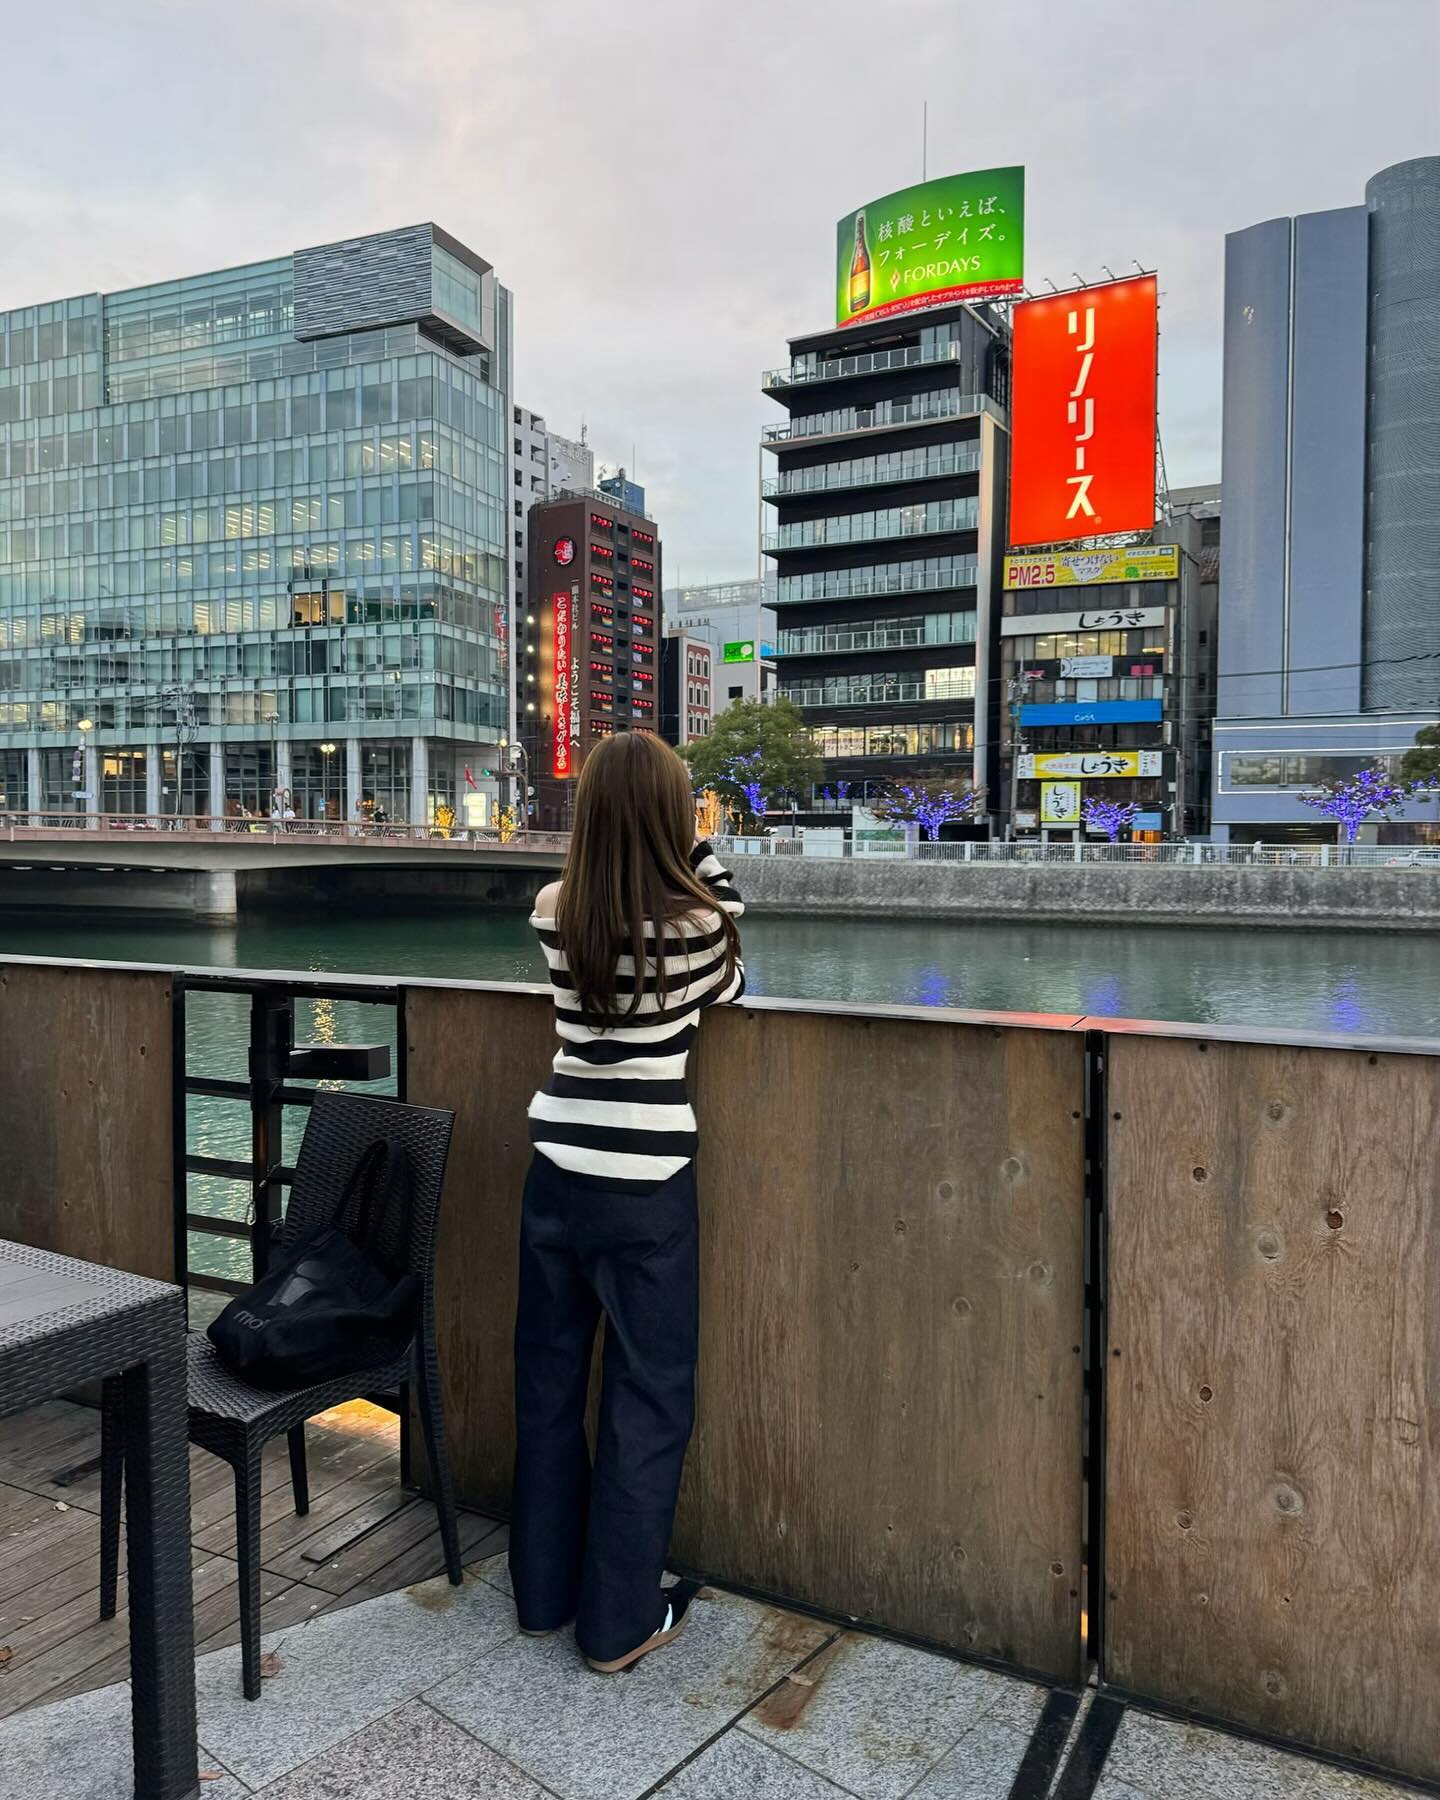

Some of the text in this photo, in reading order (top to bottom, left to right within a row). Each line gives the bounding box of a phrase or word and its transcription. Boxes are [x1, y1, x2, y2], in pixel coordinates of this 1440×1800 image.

[877, 196, 1006, 243] 核酸といえば、
[878, 224, 1007, 268] フォーデイズ。
[904, 255, 981, 284] FORDAYS
[1066, 307, 1097, 520] リノリース
[1008, 564, 1055, 587] PM2.5
[1079, 611, 1145, 629] しょうき
[1081, 757, 1128, 775] しょうき
